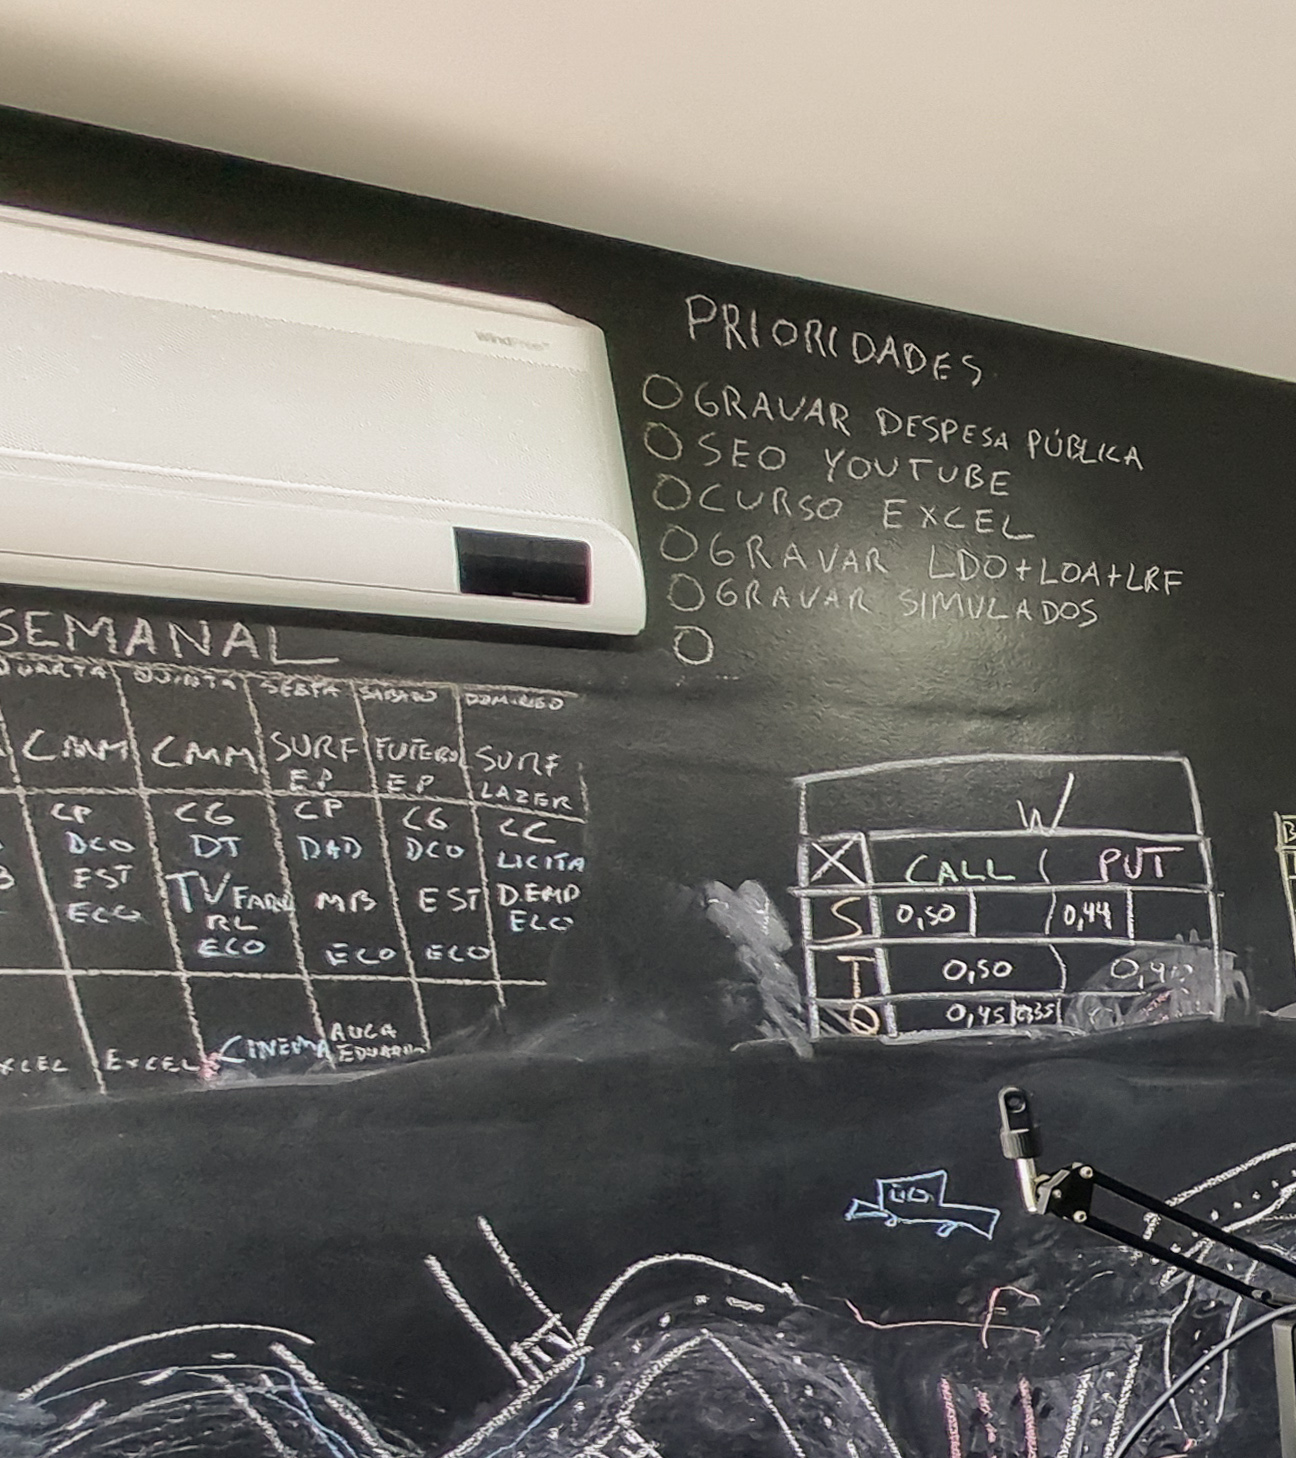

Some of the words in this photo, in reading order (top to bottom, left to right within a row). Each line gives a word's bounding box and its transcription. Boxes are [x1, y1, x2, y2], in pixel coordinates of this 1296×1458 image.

[685, 294, 983, 388] PRIORIDADES
[695, 382, 852, 436] GRAVAR
[876, 406, 1009, 451] DESPESA
[698, 431, 786, 470] SEO
[824, 448, 1010, 496] YOUTUBE
[699, 483, 842, 519] CURSO
[882, 498, 1036, 542] EXCEL
[709, 533, 888, 575] GRAVAR
[716, 578, 870, 614] GRAVAR
[900, 586, 1100, 628] SIMULADOS
[0, 608, 339, 665] SEMANAL
[270, 731, 359, 763] SURF
[480, 781, 573, 811] LAZER
[190, 834, 242, 859] DT
[71, 864, 133, 890] EST
[905, 855, 1016, 886] CALL
[1100, 846, 1185, 884] PUT
[420, 888, 482, 913] EST
[895, 902, 957, 931] 0,50
[1062, 901, 1113, 935] 0,44
[197, 937, 266, 958] ECO
[325, 942, 397, 967] ECO
[942, 958, 1013, 986] 0,50
